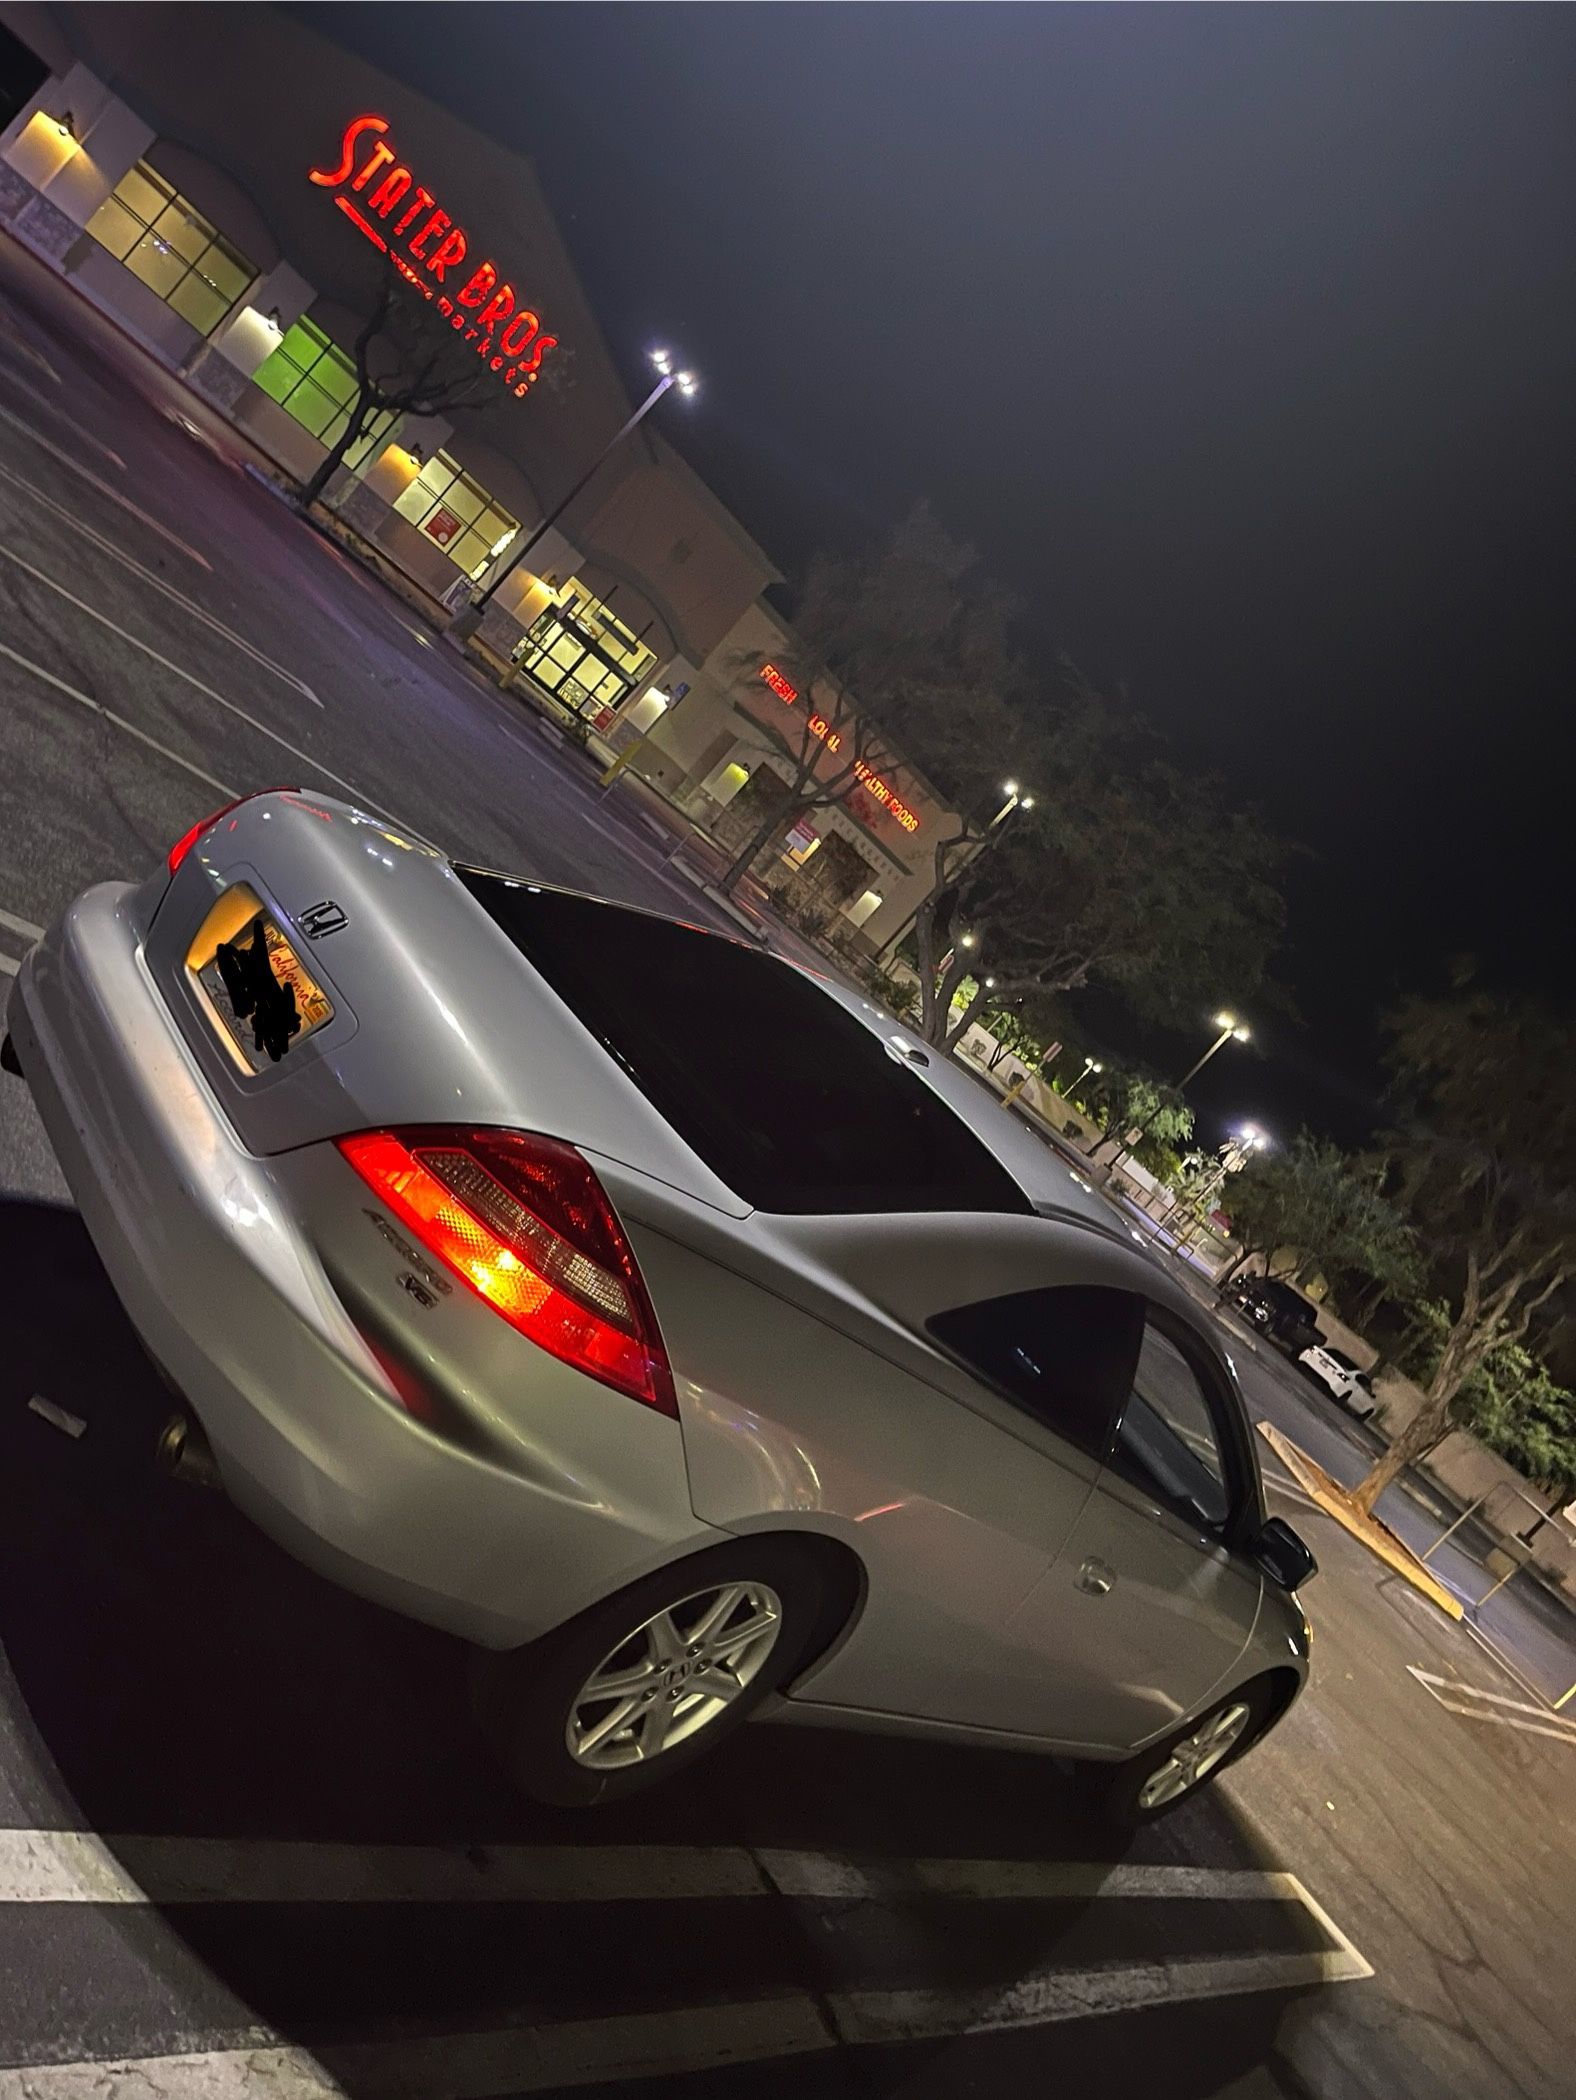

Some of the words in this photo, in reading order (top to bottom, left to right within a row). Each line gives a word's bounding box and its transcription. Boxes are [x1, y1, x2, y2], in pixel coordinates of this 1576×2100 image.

[309, 116, 467, 283] STATER
[457, 261, 558, 383] BROS.
[437, 296, 530, 398] markets
[760, 664, 798, 705] FRESH
[887, 800, 919, 833] FOODS
[269, 943, 311, 1010] California
[396, 1272, 440, 1310] V6
